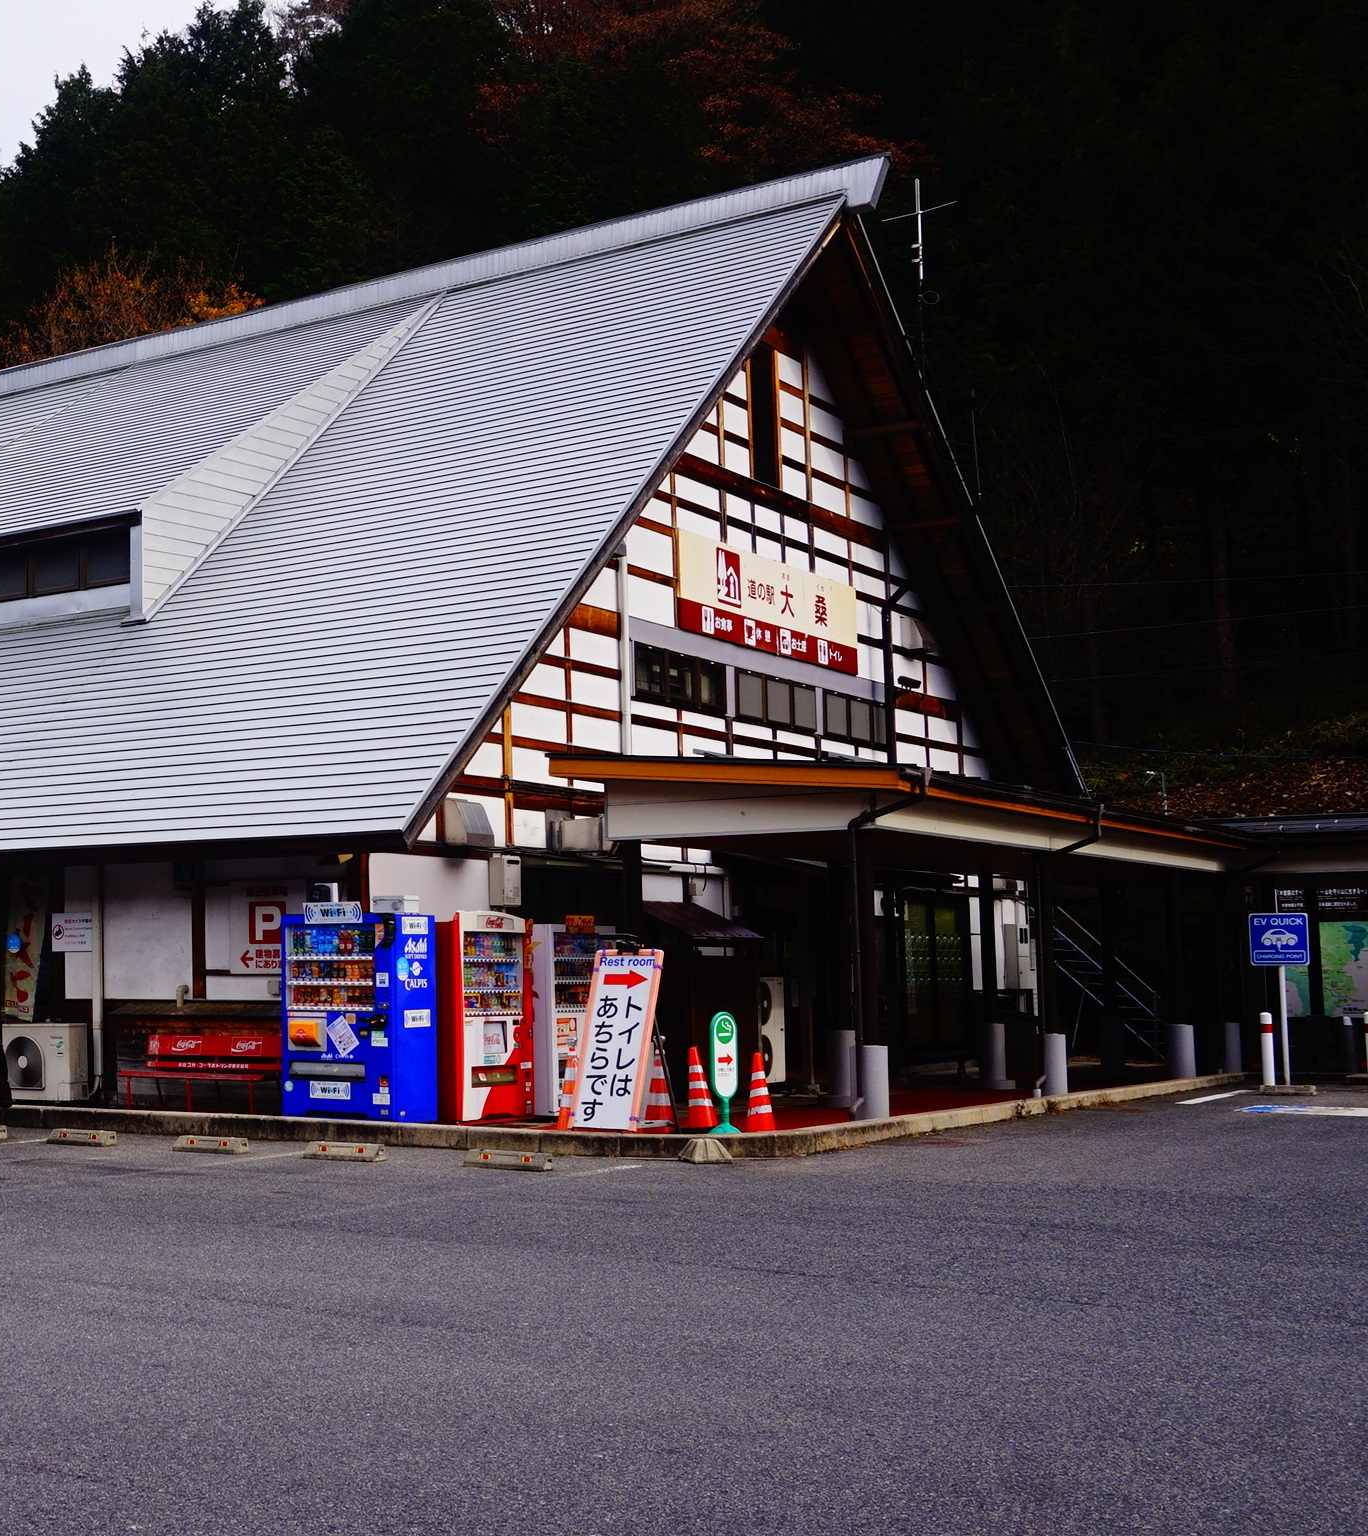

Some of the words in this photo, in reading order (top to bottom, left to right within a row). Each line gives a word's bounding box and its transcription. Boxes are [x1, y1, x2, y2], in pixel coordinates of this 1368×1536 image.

[747, 578, 775, 606] 道の駅
[780, 584, 828, 627] 大桑
[714, 615, 733, 633] お食事
[756, 627, 771, 643] 休憩
[791, 637, 808, 653] お土産
[829, 648, 843, 662] トイレ
[320, 907, 346, 917] Wi-Fi
[255, 905, 282, 941] P
[485, 916, 505, 929] Coca-Cola
[1253, 917, 1267, 926] EV
[1270, 917, 1304, 926] QUICK
[404, 937, 428, 954] Asahi
[600, 956, 625, 967] Rest
[627, 956, 655, 967] room
[404, 978, 428, 991] CALPIS
[411, 1014, 425, 1022] Wi-Fi
[610, 996, 642, 1097] トイレは
[581, 996, 618, 1121] あちらです
[320, 1086, 340, 1094] Wi-Fi
